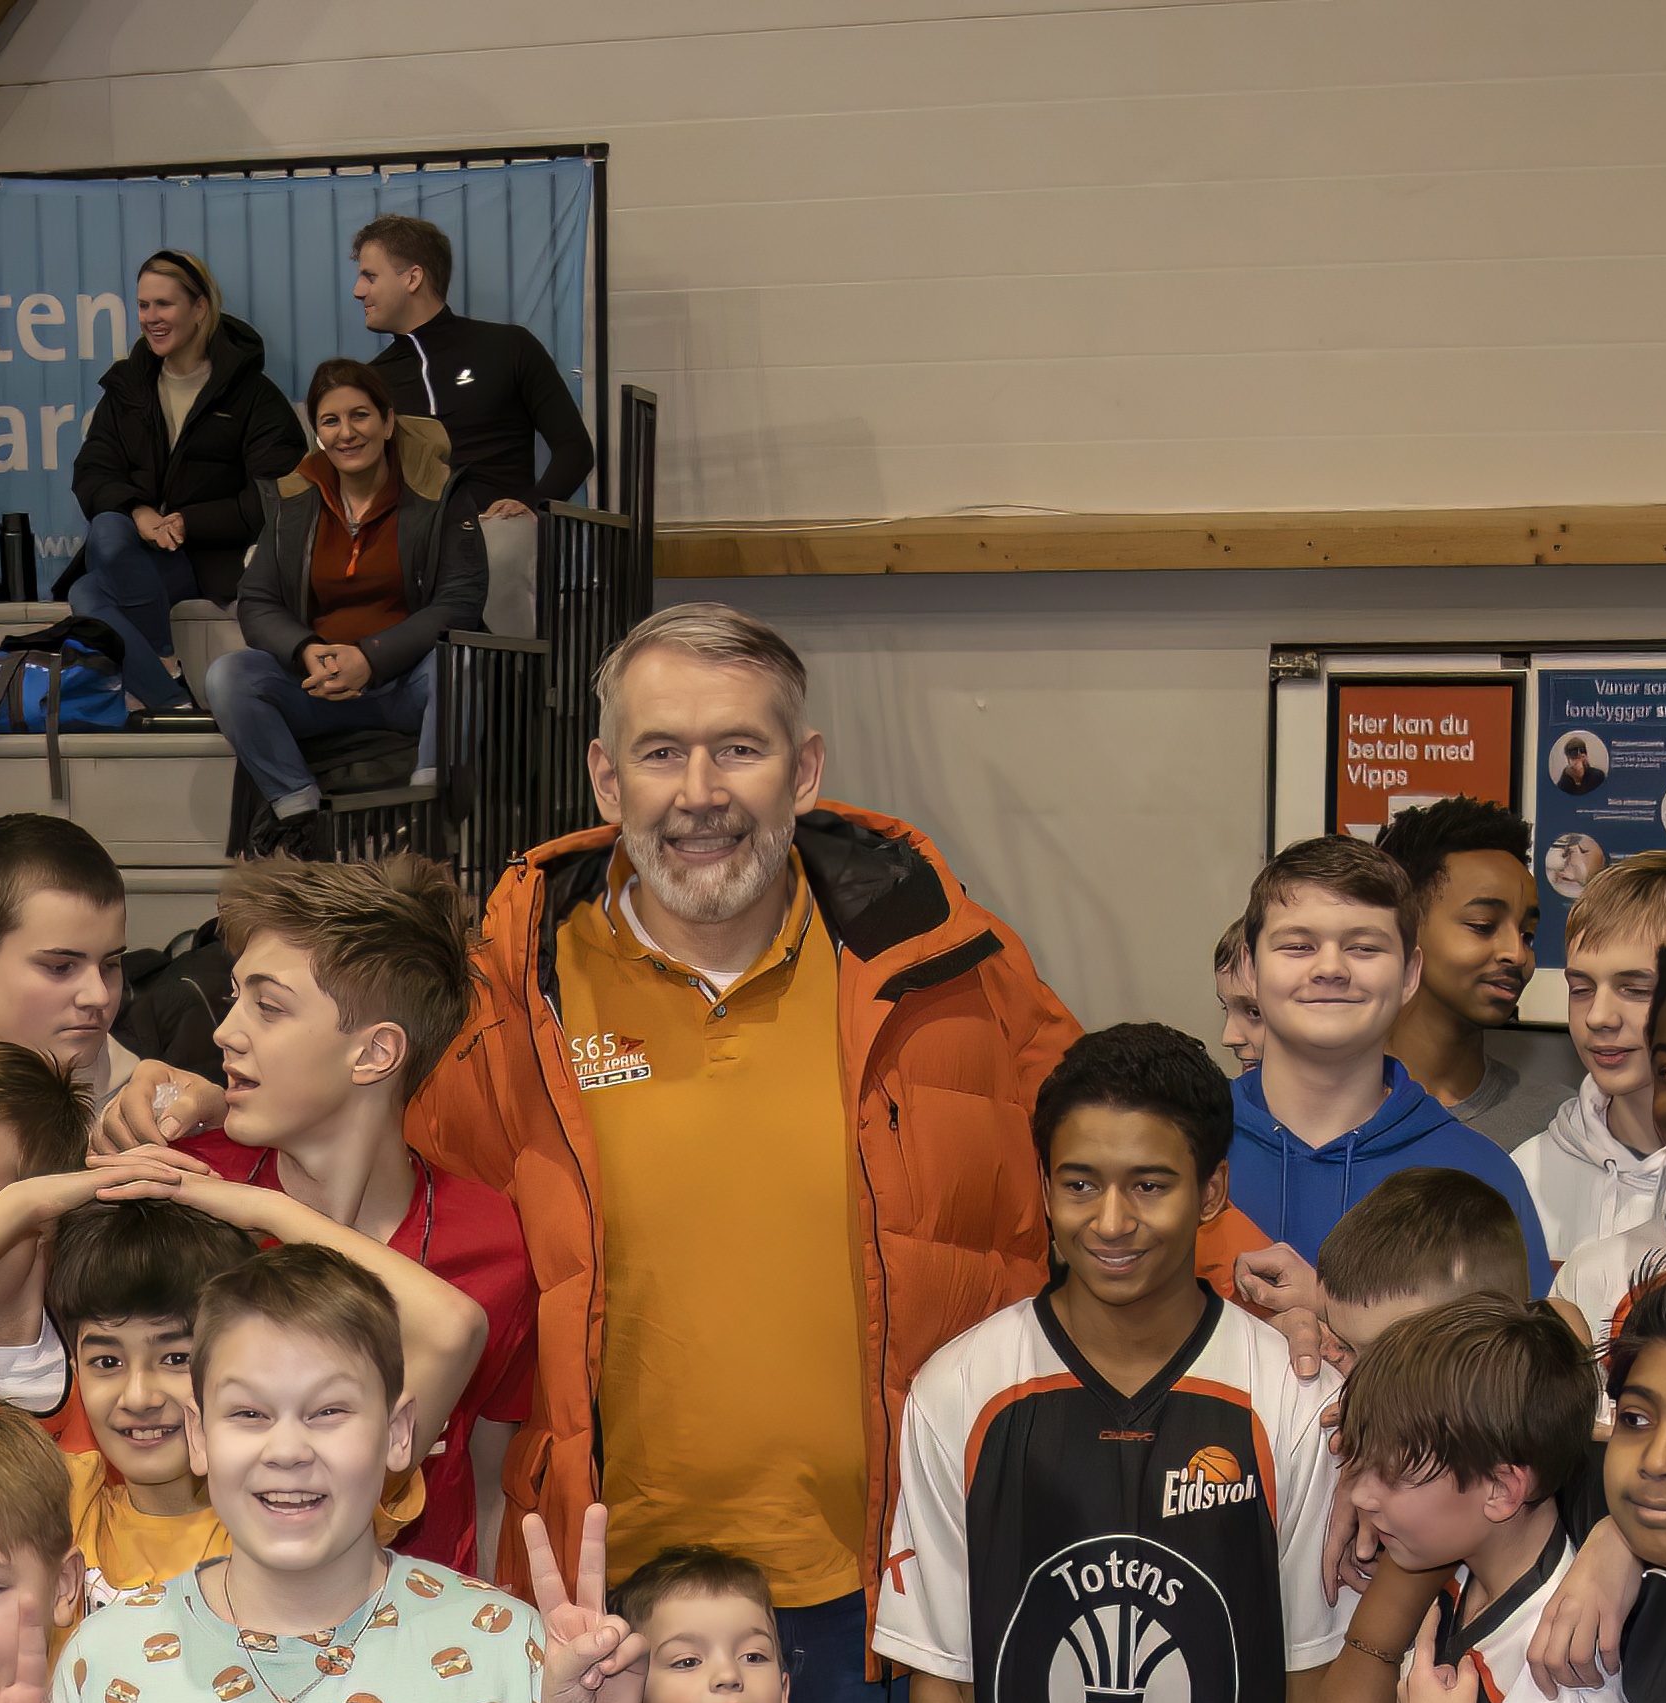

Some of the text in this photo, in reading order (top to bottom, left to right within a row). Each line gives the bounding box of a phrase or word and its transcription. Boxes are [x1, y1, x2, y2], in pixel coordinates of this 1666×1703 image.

[1348, 713, 1469, 736] Her kan du
[1348, 739, 1475, 761] betale med
[1347, 764, 1408, 790] Vipps
[1050, 1549, 1185, 1607] Totens
